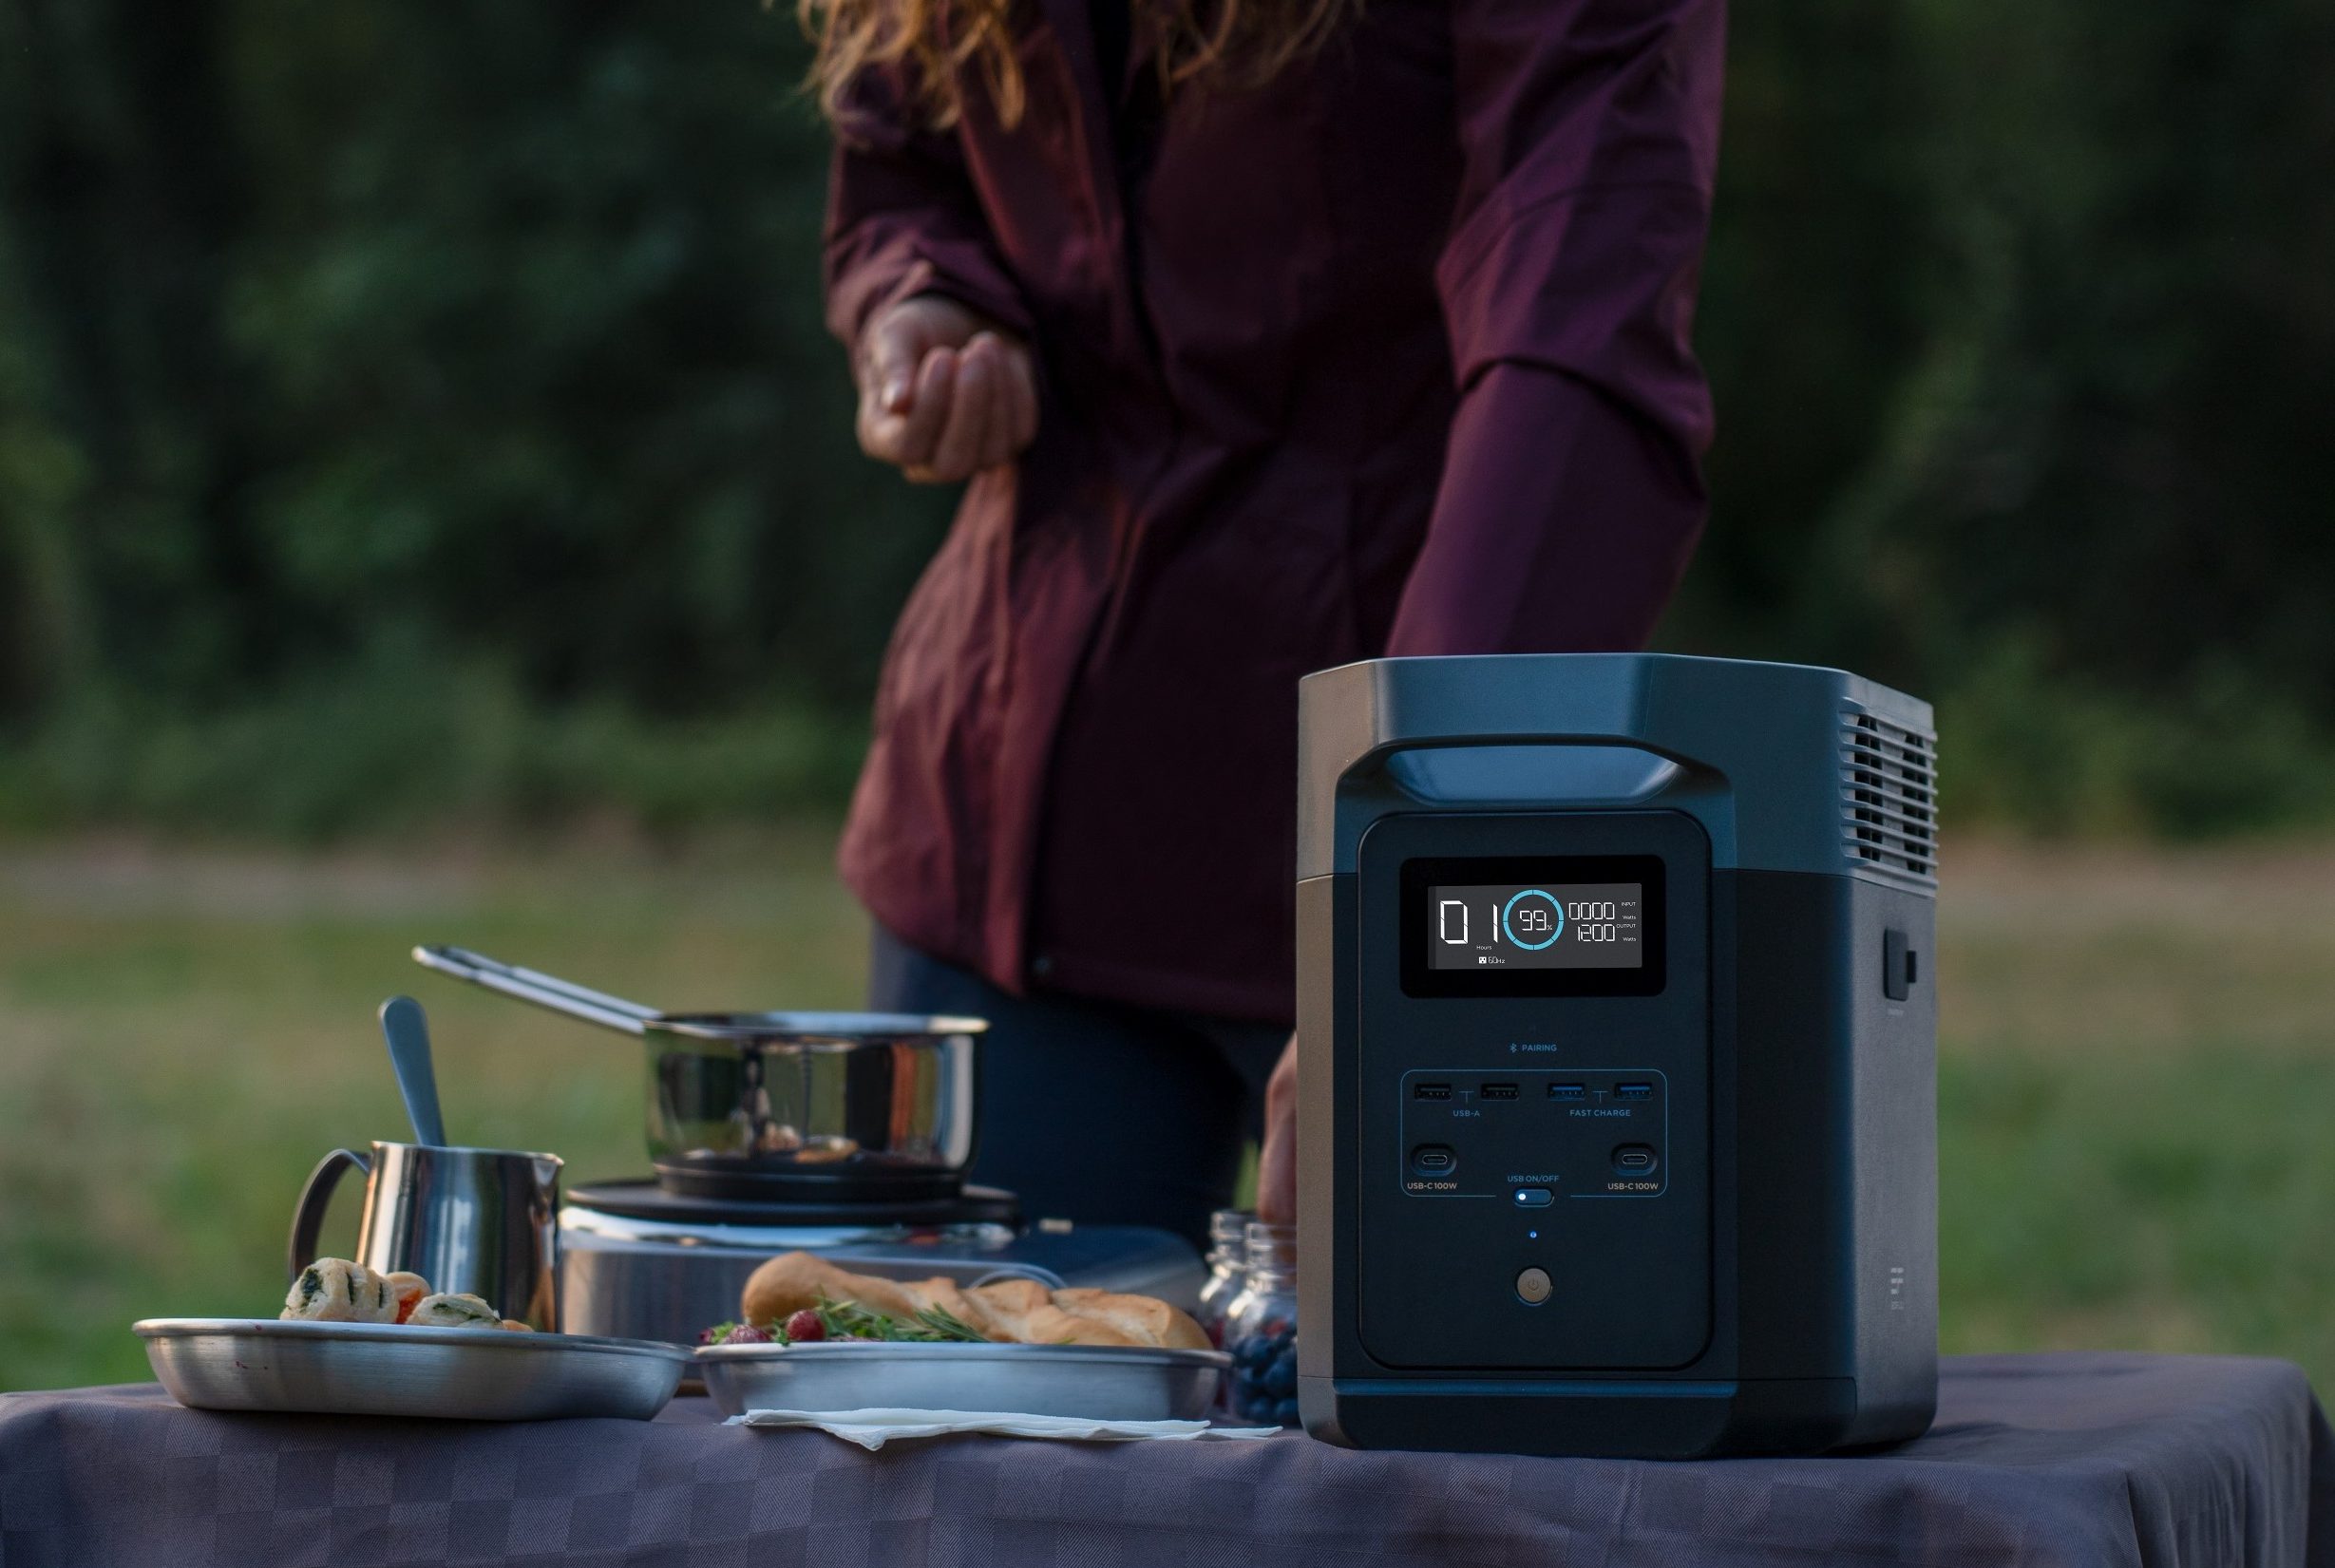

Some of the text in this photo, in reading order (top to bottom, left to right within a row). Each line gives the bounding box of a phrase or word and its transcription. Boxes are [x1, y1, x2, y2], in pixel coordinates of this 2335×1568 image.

[1568, 902, 1616, 920] 0000
[1577, 923, 1616, 942] 1200
[1522, 1044, 1558, 1052] PAIRING
[1452, 1109, 1481, 1118] USB-A
[1569, 1109, 1631, 1118] FAST CHARGE
[1507, 1174, 1559, 1184] USB ON/OFF
[1407, 1181, 1458, 1190] USB-C 100W
[1607, 1181, 1659, 1190] USB-C 100W
